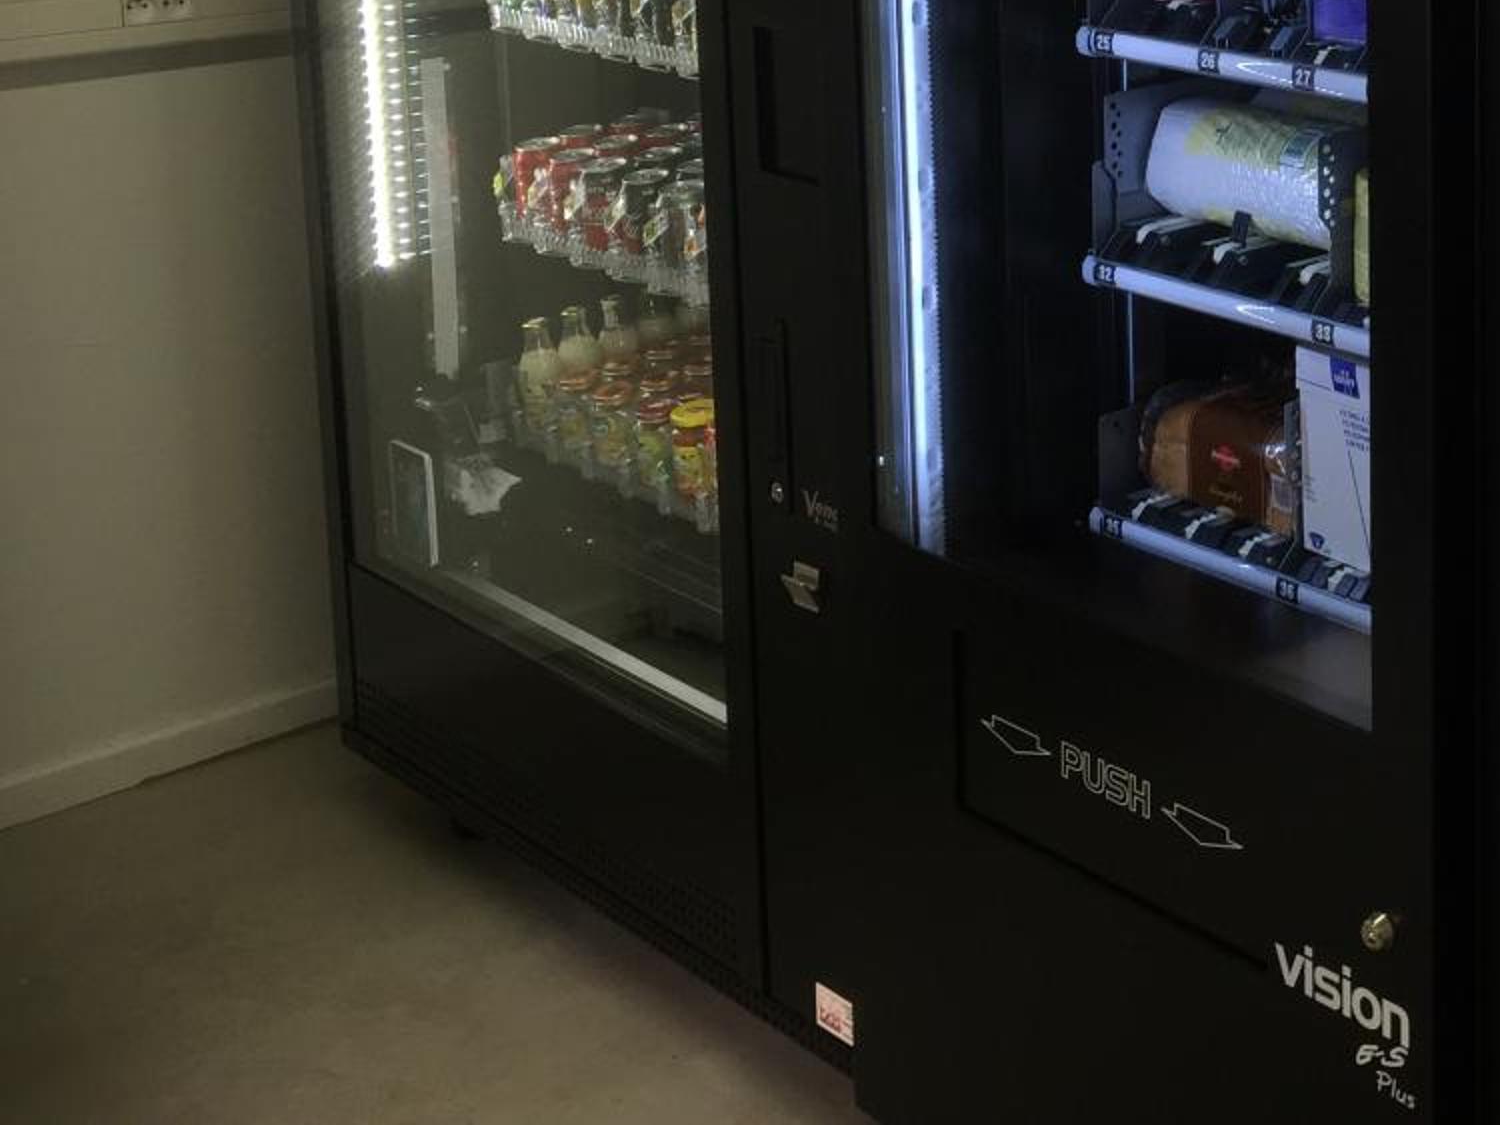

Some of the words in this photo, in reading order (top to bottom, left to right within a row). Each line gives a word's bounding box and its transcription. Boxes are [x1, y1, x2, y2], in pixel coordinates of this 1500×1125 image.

[1096, 34, 1110, 51] 25
[1059, 739, 1152, 821] PUSH
[1375, 1070, 1416, 1110] Plus
